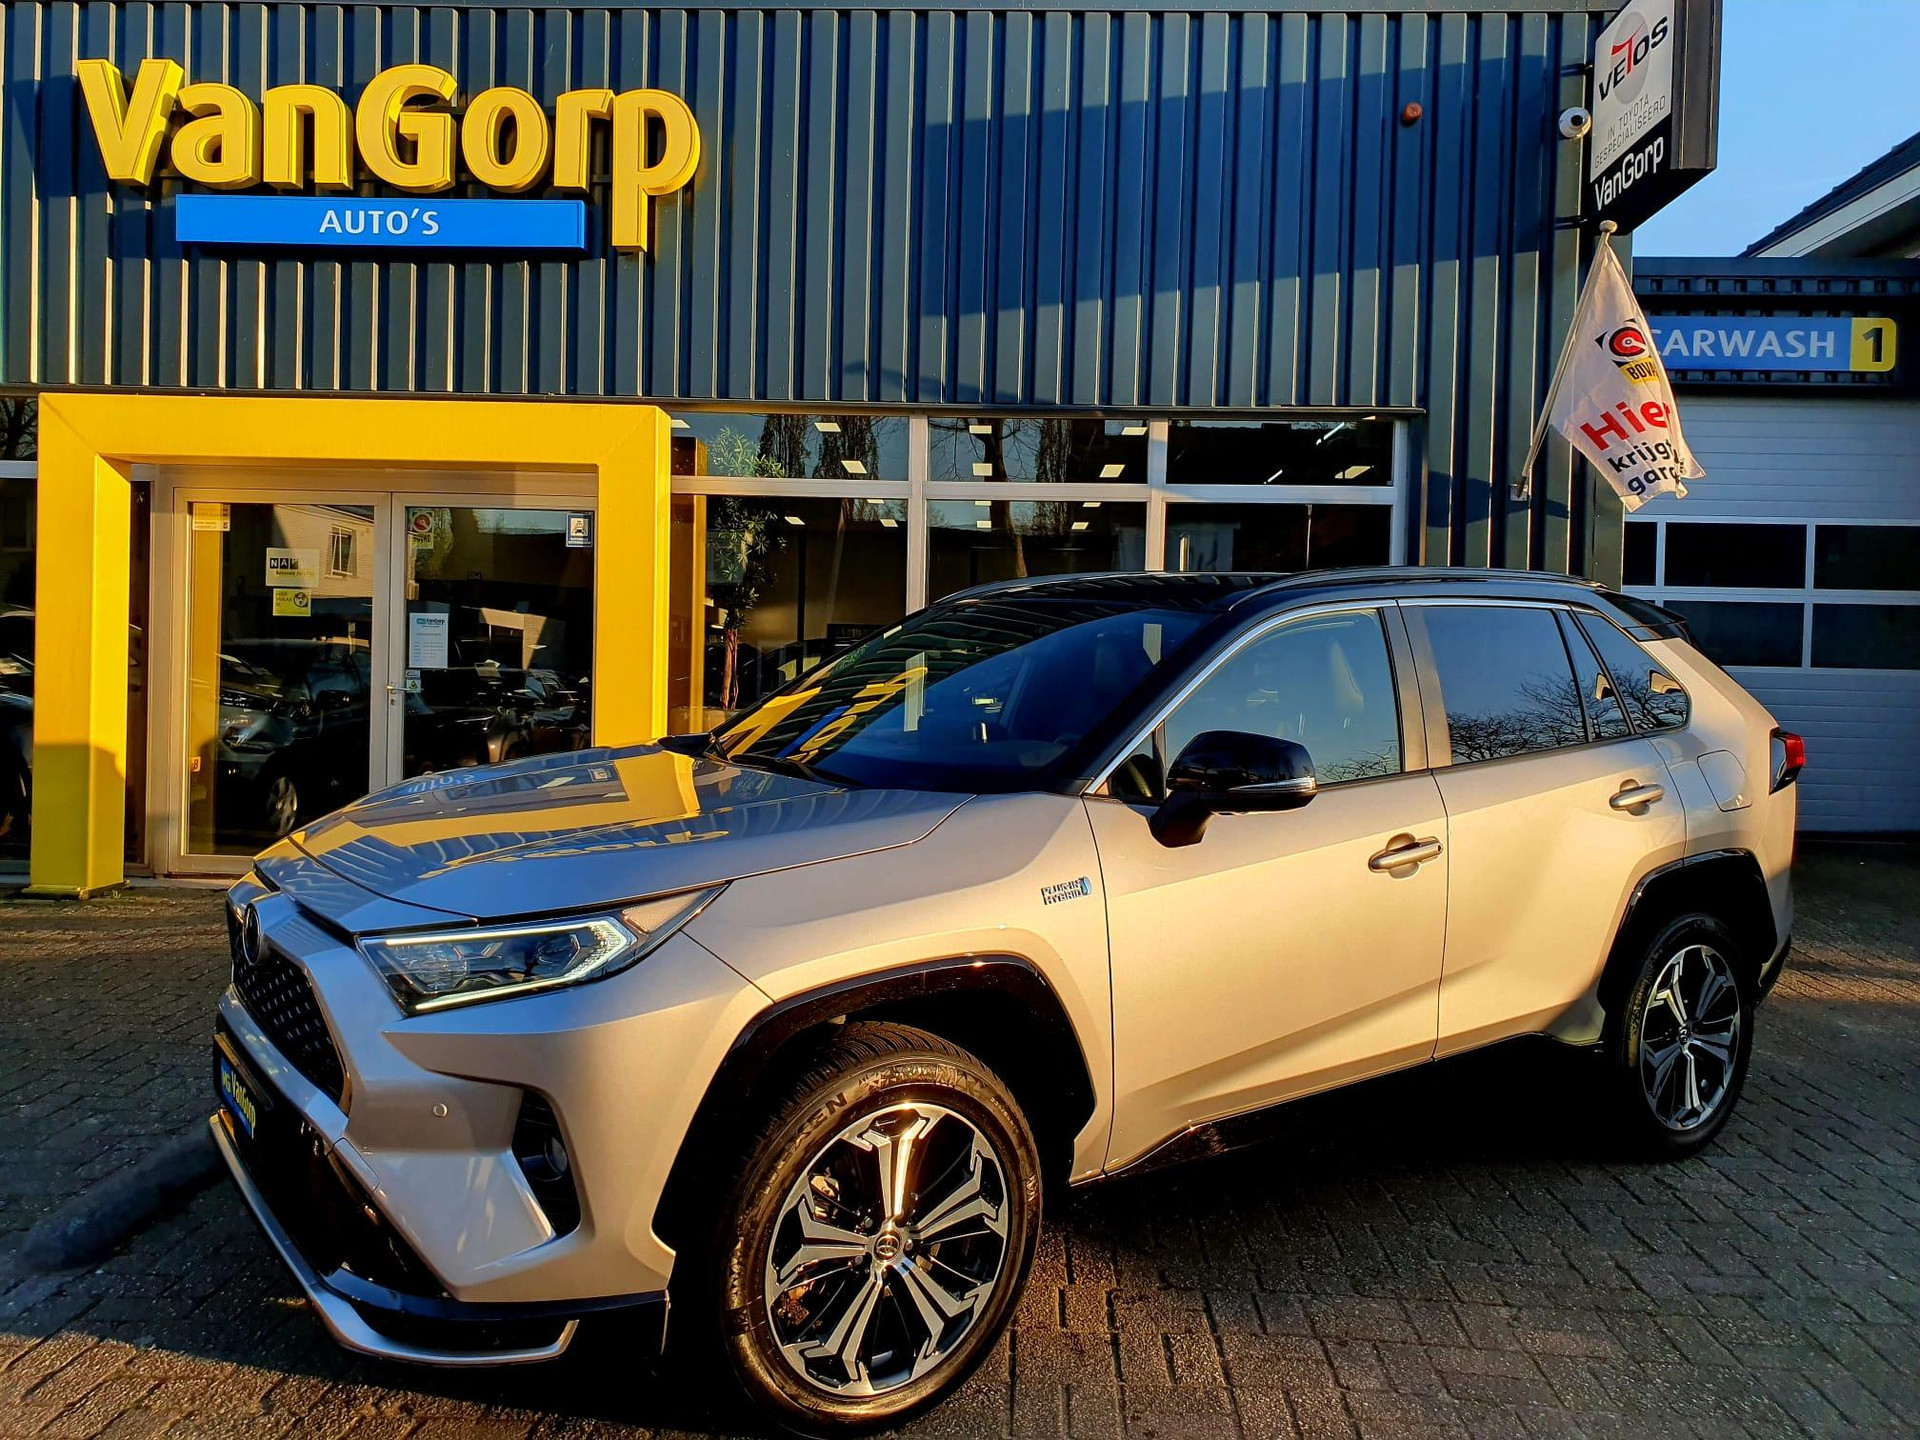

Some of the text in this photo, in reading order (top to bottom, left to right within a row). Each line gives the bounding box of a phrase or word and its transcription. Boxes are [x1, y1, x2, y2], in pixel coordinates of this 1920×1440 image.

[1598, 16, 1669, 101] VETOS
[1594, 94, 1666, 169] GESPECIALISEERD
[1606, 94, 1650, 142] IN TOYOTA
[77, 59, 701, 252] VanGorp
[1594, 136, 1664, 212] VanGorp
[318, 207, 440, 236] AUTO'S
[1626, 361, 1659, 380] BOVA
[1861, 326, 1884, 364] 1
